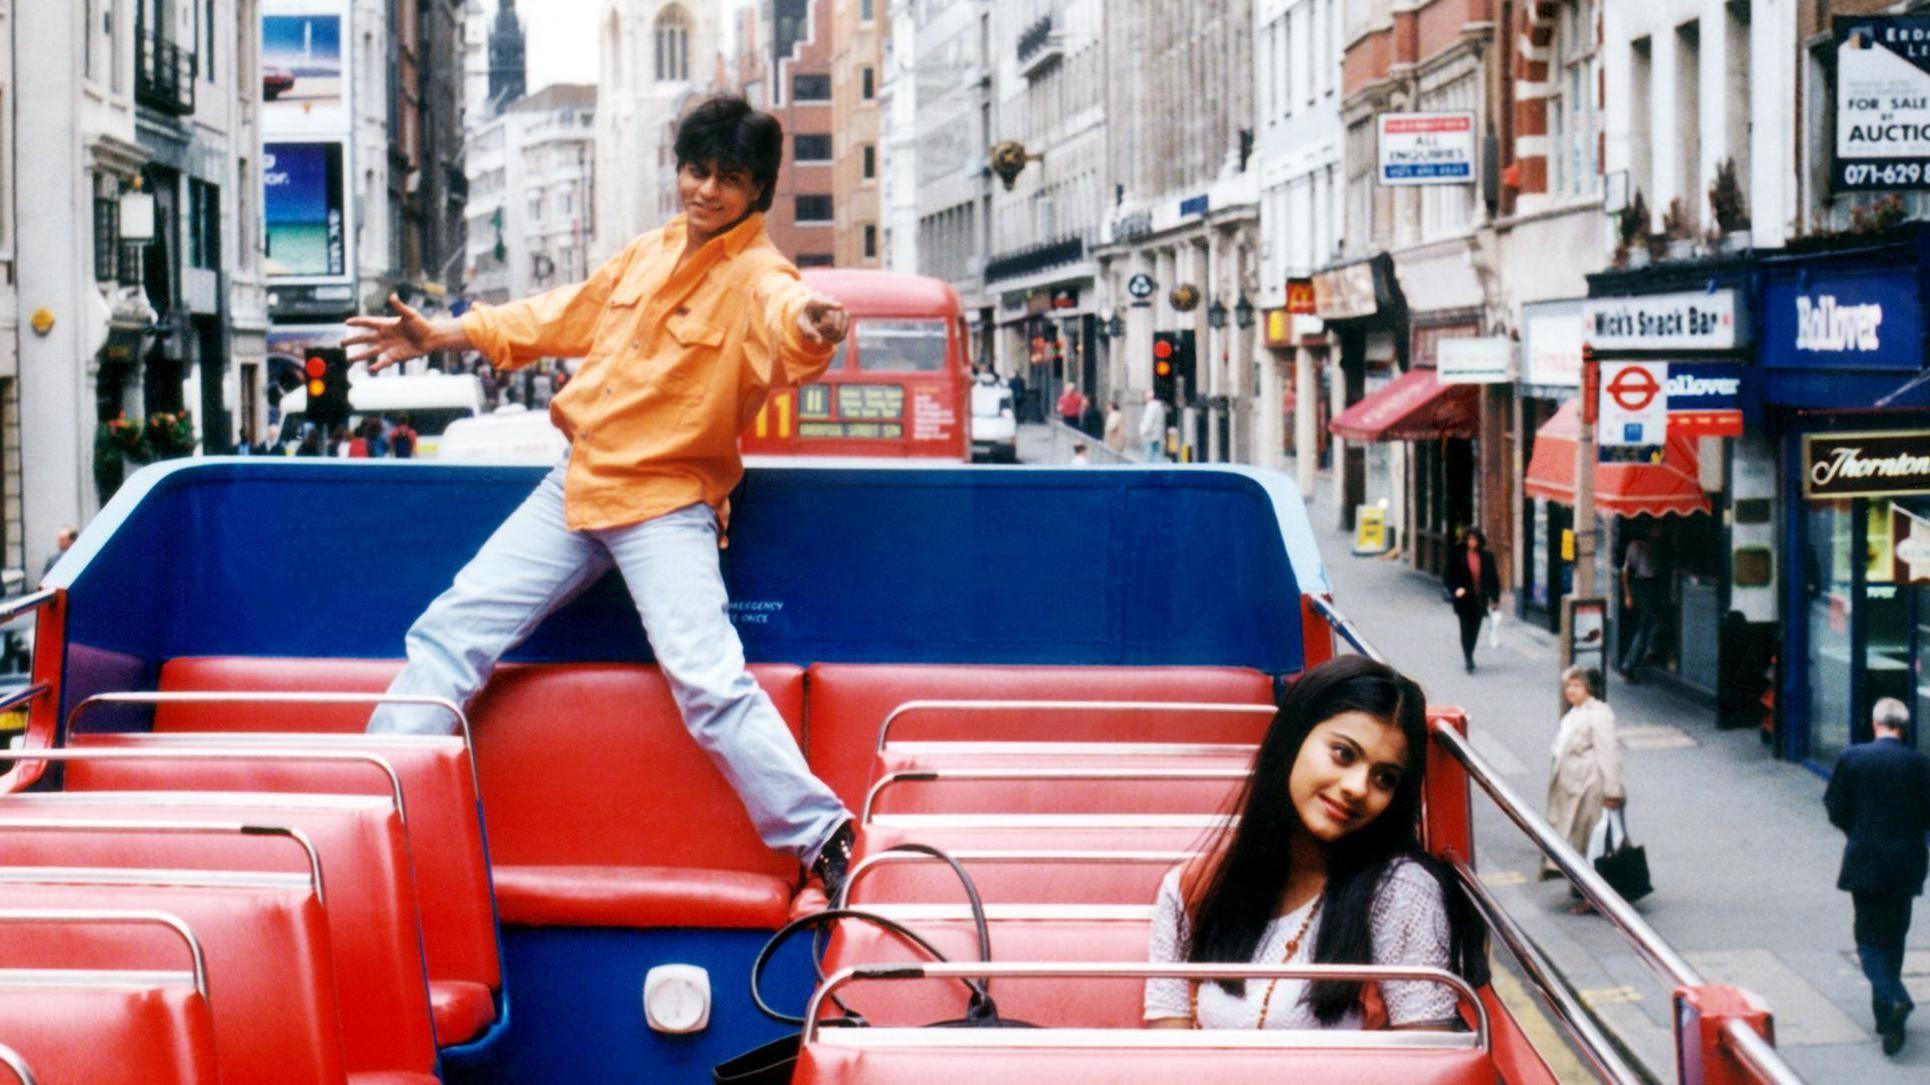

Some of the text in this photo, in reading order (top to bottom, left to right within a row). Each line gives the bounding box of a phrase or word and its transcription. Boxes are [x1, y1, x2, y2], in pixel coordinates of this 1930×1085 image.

[1886, 27, 1930, 42] ERD
[1848, 97, 1926, 110] FOR SALE
[1844, 163, 1921, 185] 071-629
[1665, 374, 1741, 396] ollover
